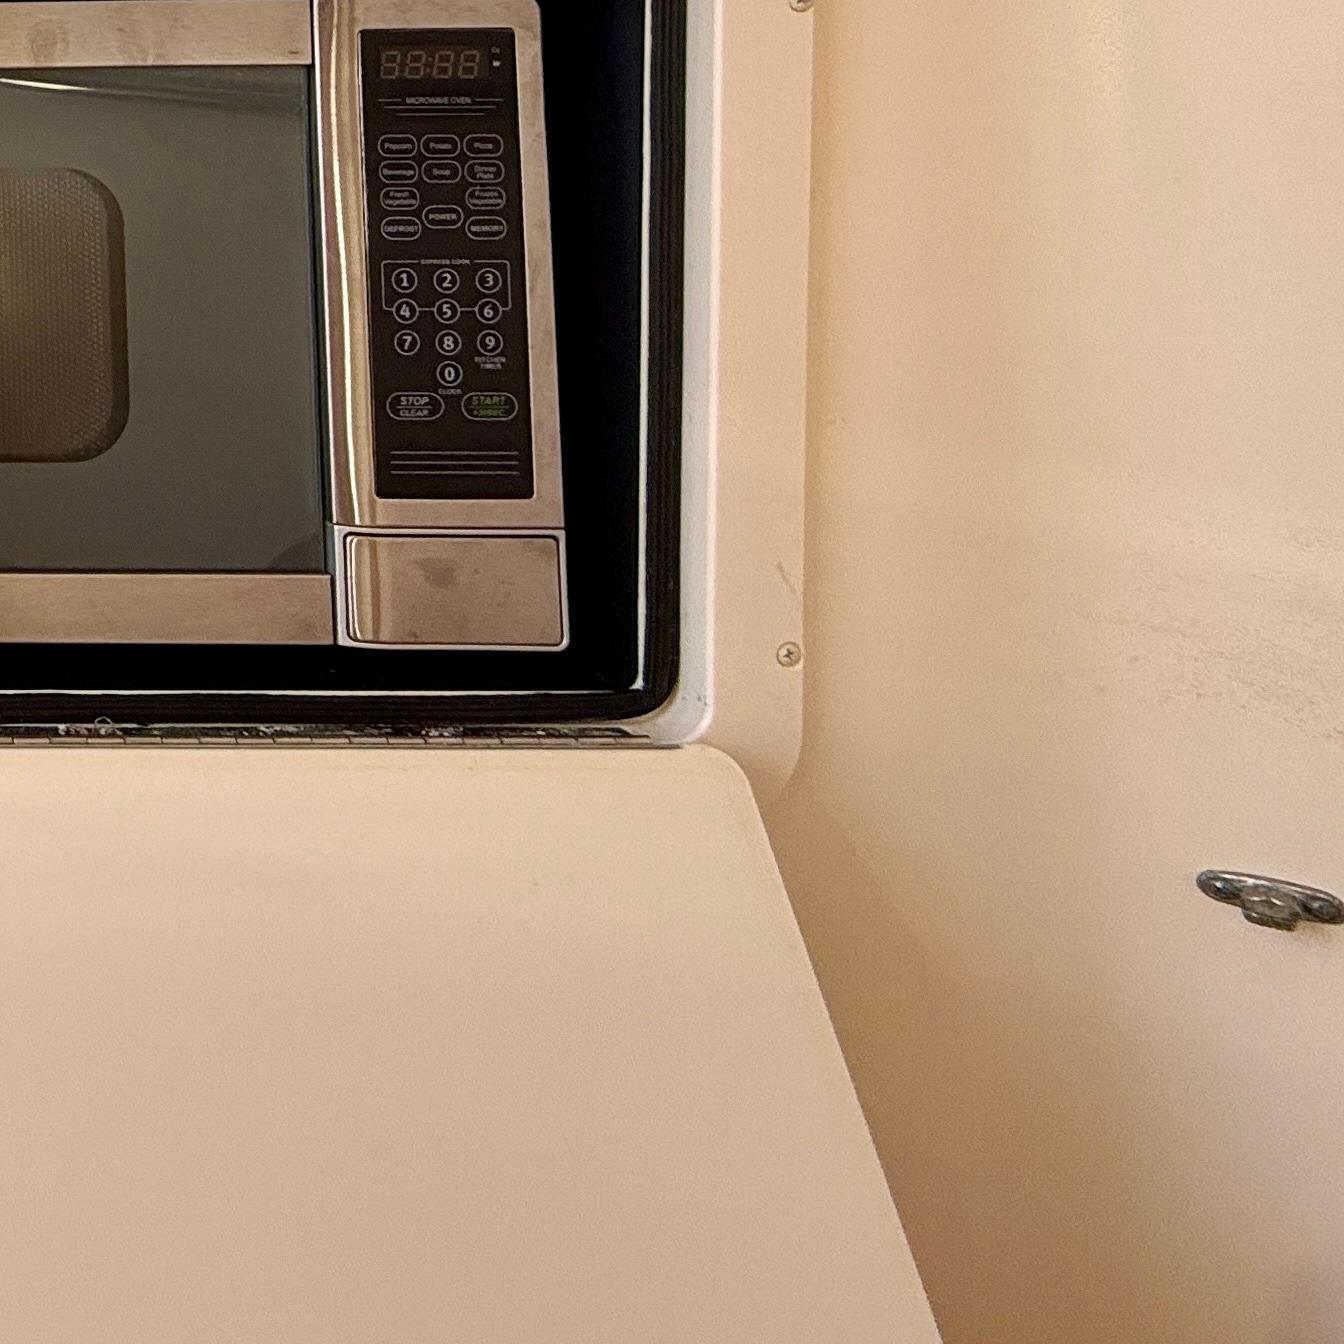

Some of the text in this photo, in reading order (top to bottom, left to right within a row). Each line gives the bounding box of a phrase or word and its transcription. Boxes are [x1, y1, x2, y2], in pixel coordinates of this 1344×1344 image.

[405, 96, 472, 105] MICROWAVE OVEN
[428, 213, 458, 221] POWER
[384, 225, 418, 233] DEFROST
[399, 272, 410, 287] 1
[441, 272, 453, 287] 2
[483, 273, 494, 287] 3
[400, 303, 411, 319] 4
[442, 303, 453, 318] 5
[483, 303, 493, 318] 6
[402, 335, 413, 351] 7
[442, 335, 454, 351] 8
[485, 335, 496, 350] 9
[444, 366, 455, 382] 0
[400, 396, 430, 405] STOP
[471, 396, 506, 405] START
[399, 409, 430, 417] CLEAR
